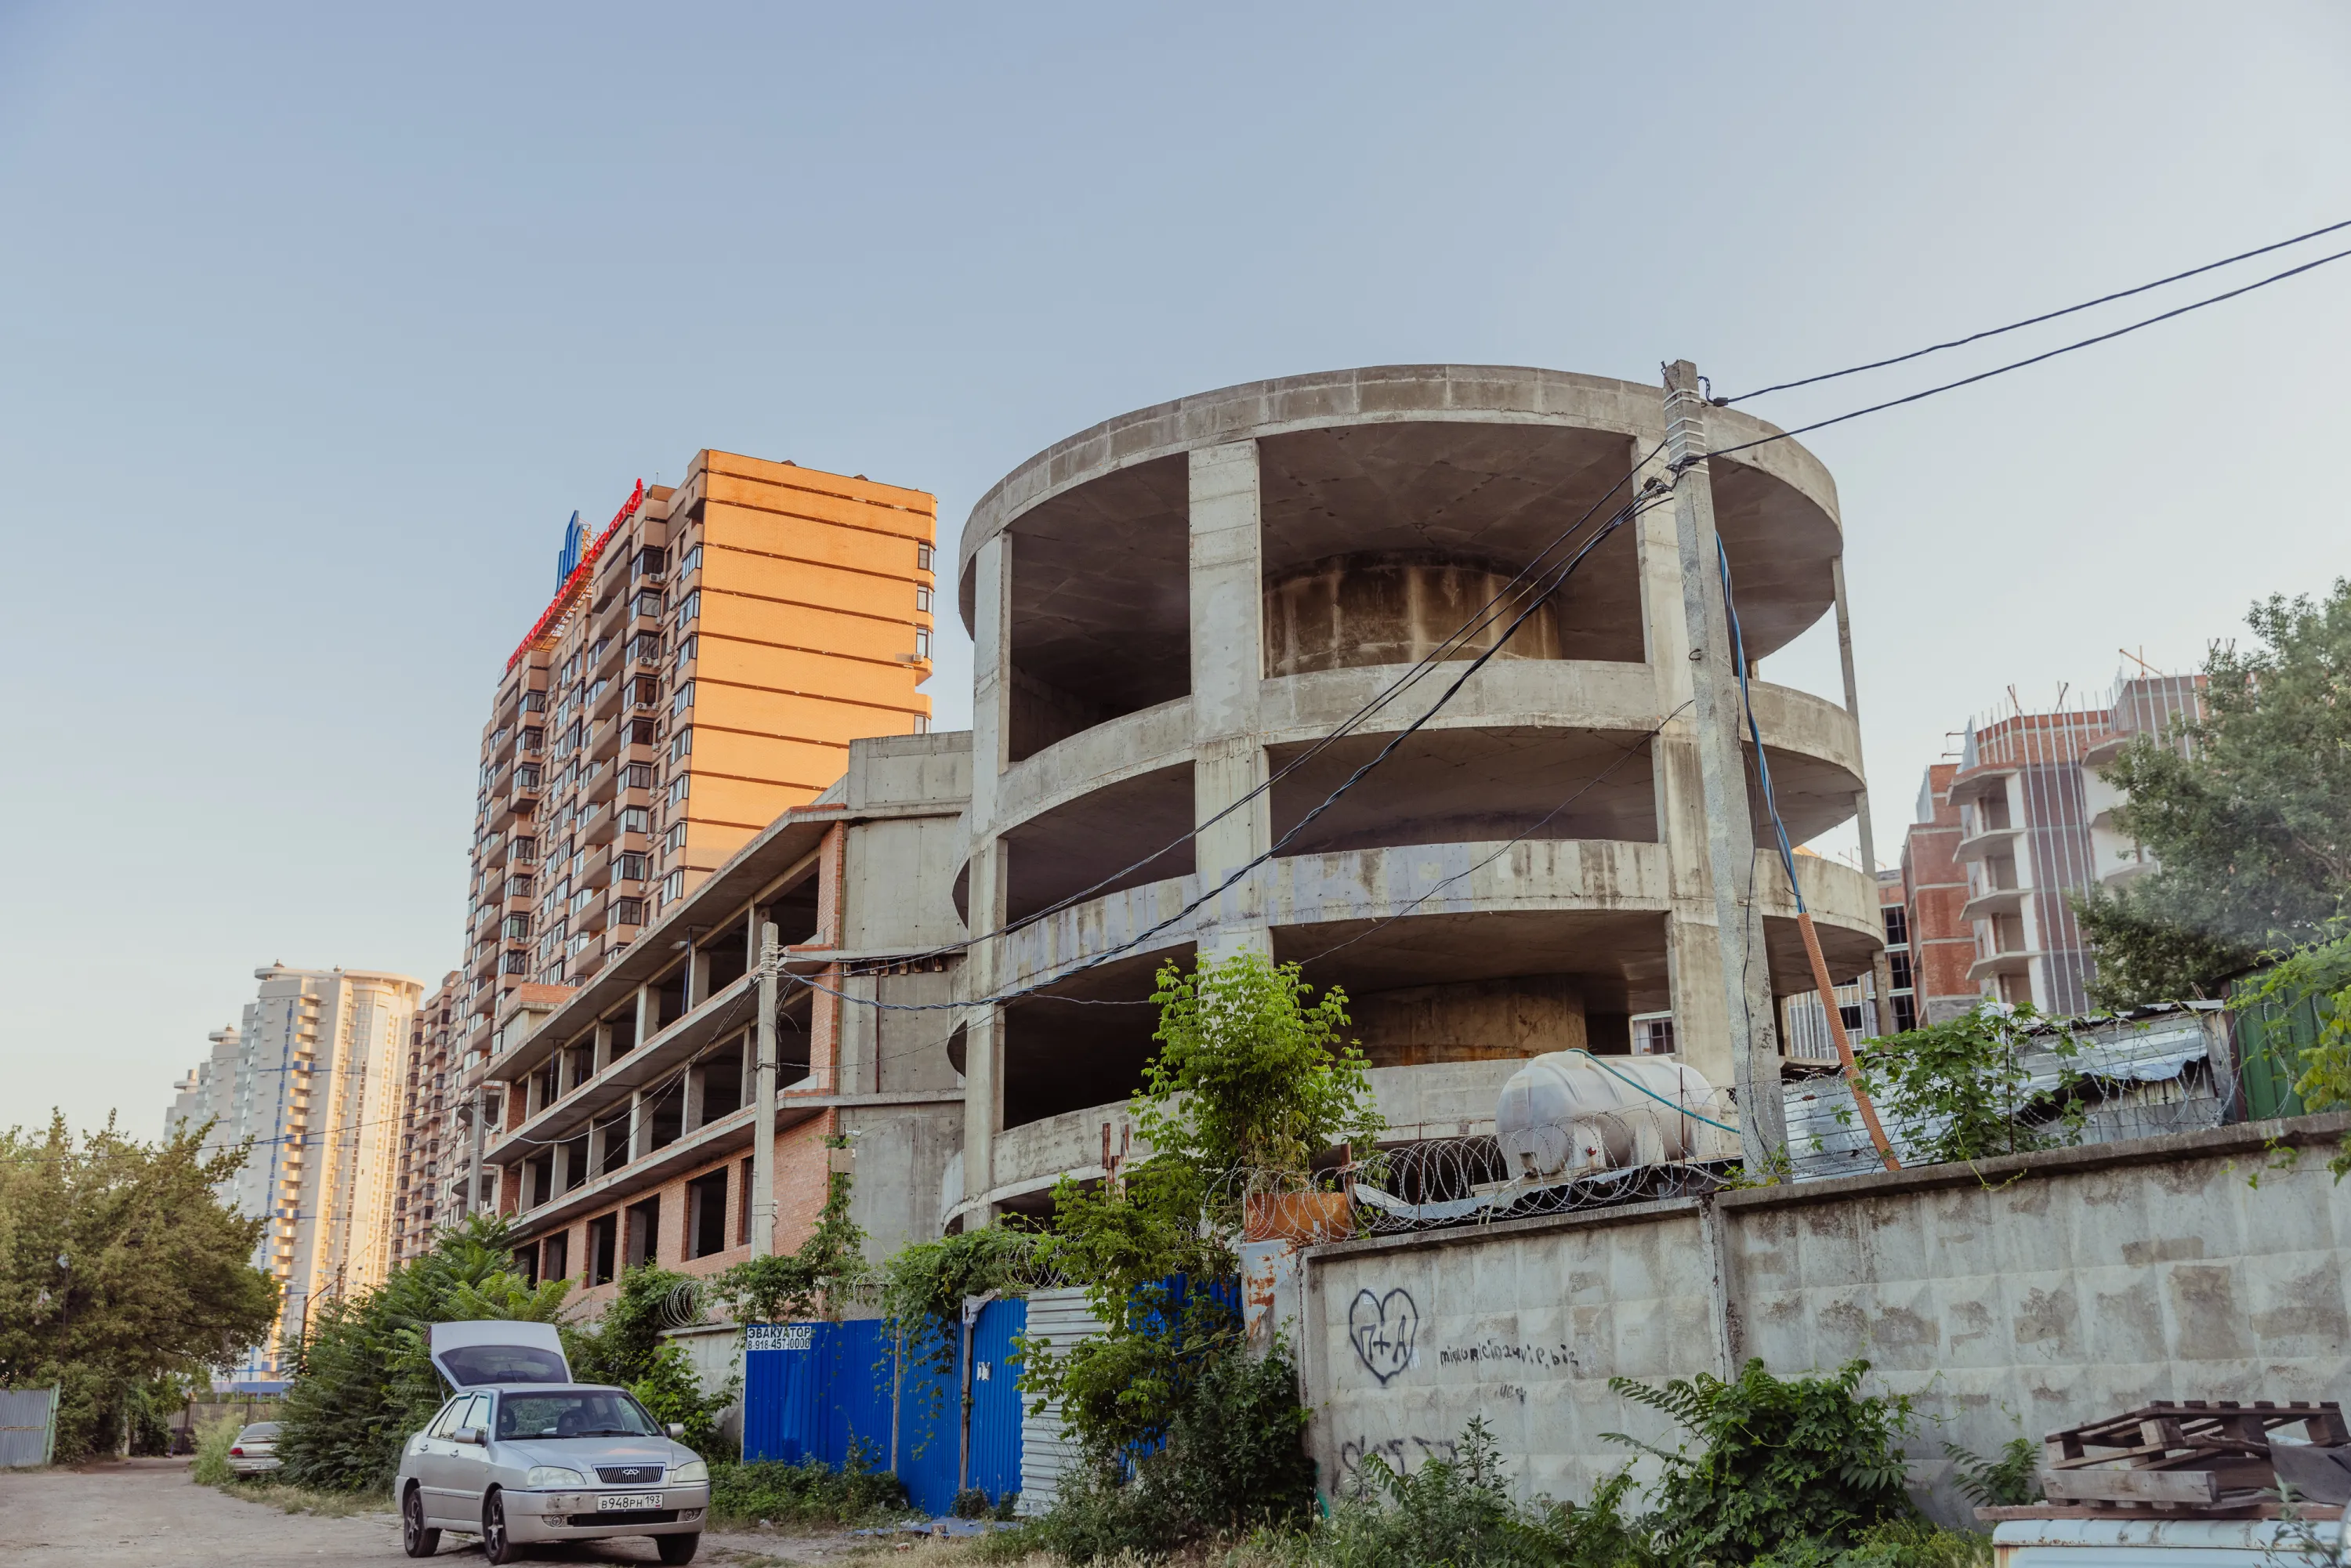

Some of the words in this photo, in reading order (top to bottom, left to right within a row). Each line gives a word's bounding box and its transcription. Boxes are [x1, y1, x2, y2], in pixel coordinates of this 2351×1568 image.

[748, 1327, 810, 1338] ЭВАКУАТОР
[748, 1338, 810, 1350] 8-918-457-0008
[601, 1497, 643, 1508] В948РН
[644, 1495, 661, 1505] 193
